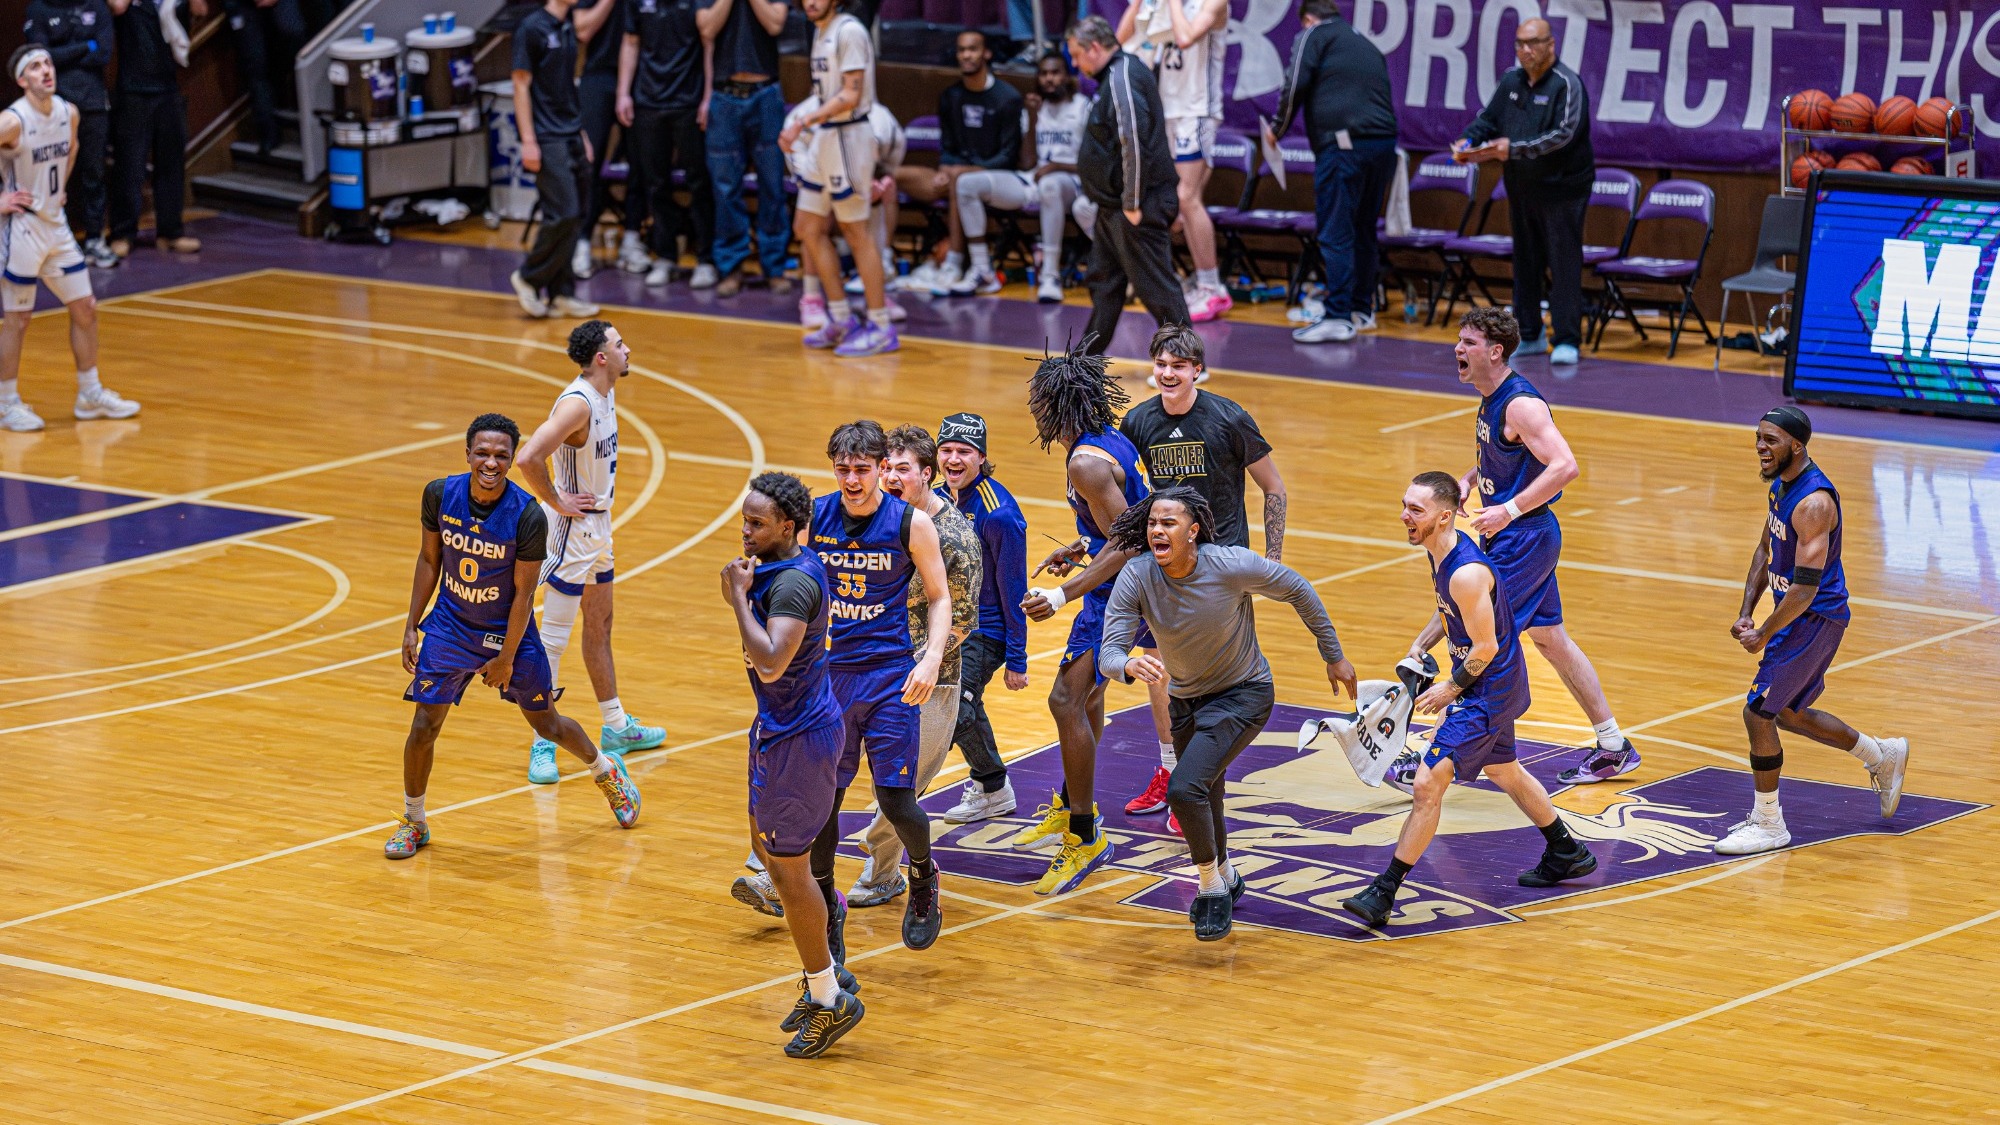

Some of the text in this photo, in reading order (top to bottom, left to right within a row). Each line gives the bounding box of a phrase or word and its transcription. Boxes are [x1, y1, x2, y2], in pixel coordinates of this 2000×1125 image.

[1165, 42, 1183, 70] 23
[50, 165, 58, 195] 0
[1648, 192, 1705, 207] MUSTANGS
[1151, 445, 1205, 470] LAURIER
[1153, 465, 1205, 476] BASKETBALL
[442, 528, 507, 560] GOLDEN
[459, 557, 479, 583] 0
[817, 551, 892, 571] GOLDEN
[445, 571, 500, 604] HAWKS
[837, 572, 867, 599] 33
[828, 597, 886, 621] AWKS
